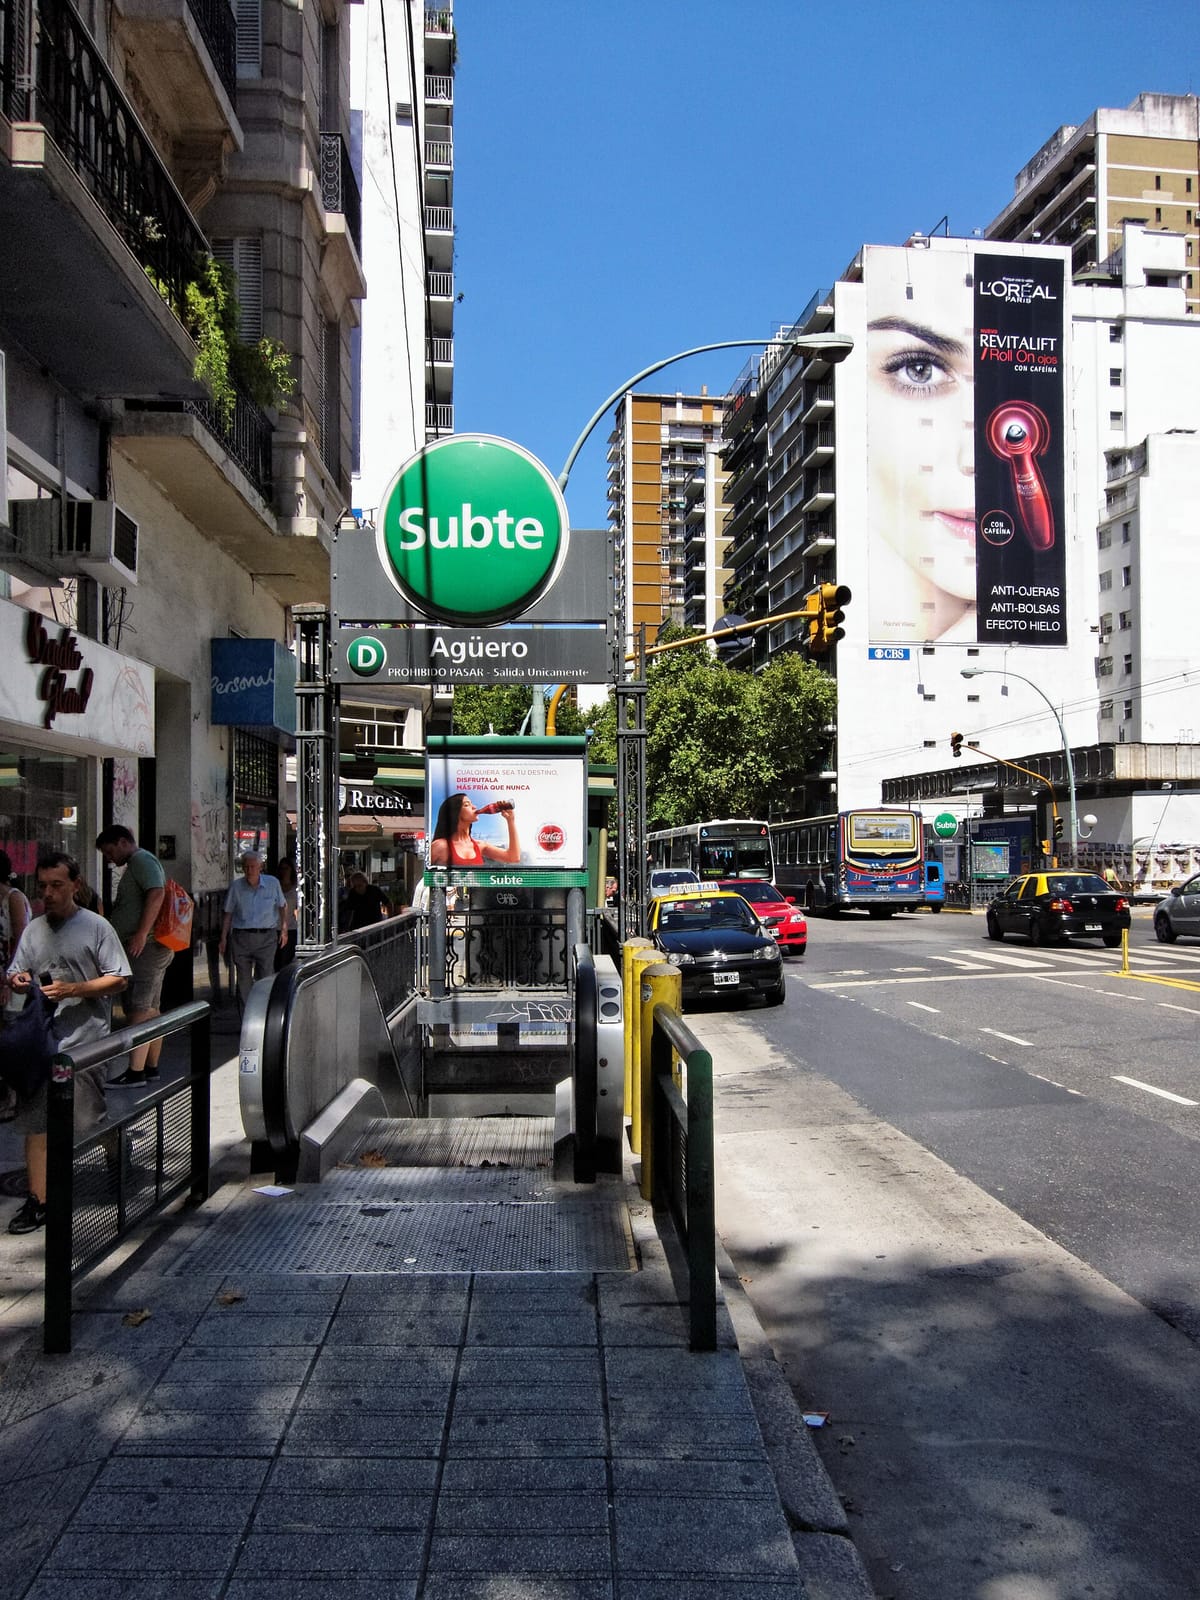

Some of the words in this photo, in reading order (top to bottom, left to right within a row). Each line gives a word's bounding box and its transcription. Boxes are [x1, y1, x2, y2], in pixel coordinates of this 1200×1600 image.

[980, 281, 1057, 299] L'ORÉAL
[1005, 296, 1031, 304] PARIS
[980, 334, 1057, 351] REVITALIFT
[1016, 350, 1035, 363] On
[1038, 354, 1057, 365] ojos
[399, 503, 544, 550] Subte
[984, 527, 1011, 535] CAFEÍNA
[991, 585, 1060, 597] ANTI-OJERAS
[990, 602, 1060, 614] ANTI-BOLSAS
[986, 619, 1027, 630] EFECTO
[1029, 621, 1061, 631] HIELO
[357, 644, 377, 667] D
[430, 636, 528, 663] Agüero
[884, 648, 905, 659] CBS
[388, 667, 446, 677] PROHIBIDO
[450, 667, 484, 677] PASAR
[493, 667, 525, 677] Salida
[528, 667, 589, 677] Unicamente
[211, 668, 274, 694] Personal
[456, 783, 472, 791] MÁS
[473, 783, 489, 791] FRÍA
[936, 821, 957, 829] Subte
[490, 875, 523, 885] Subte
